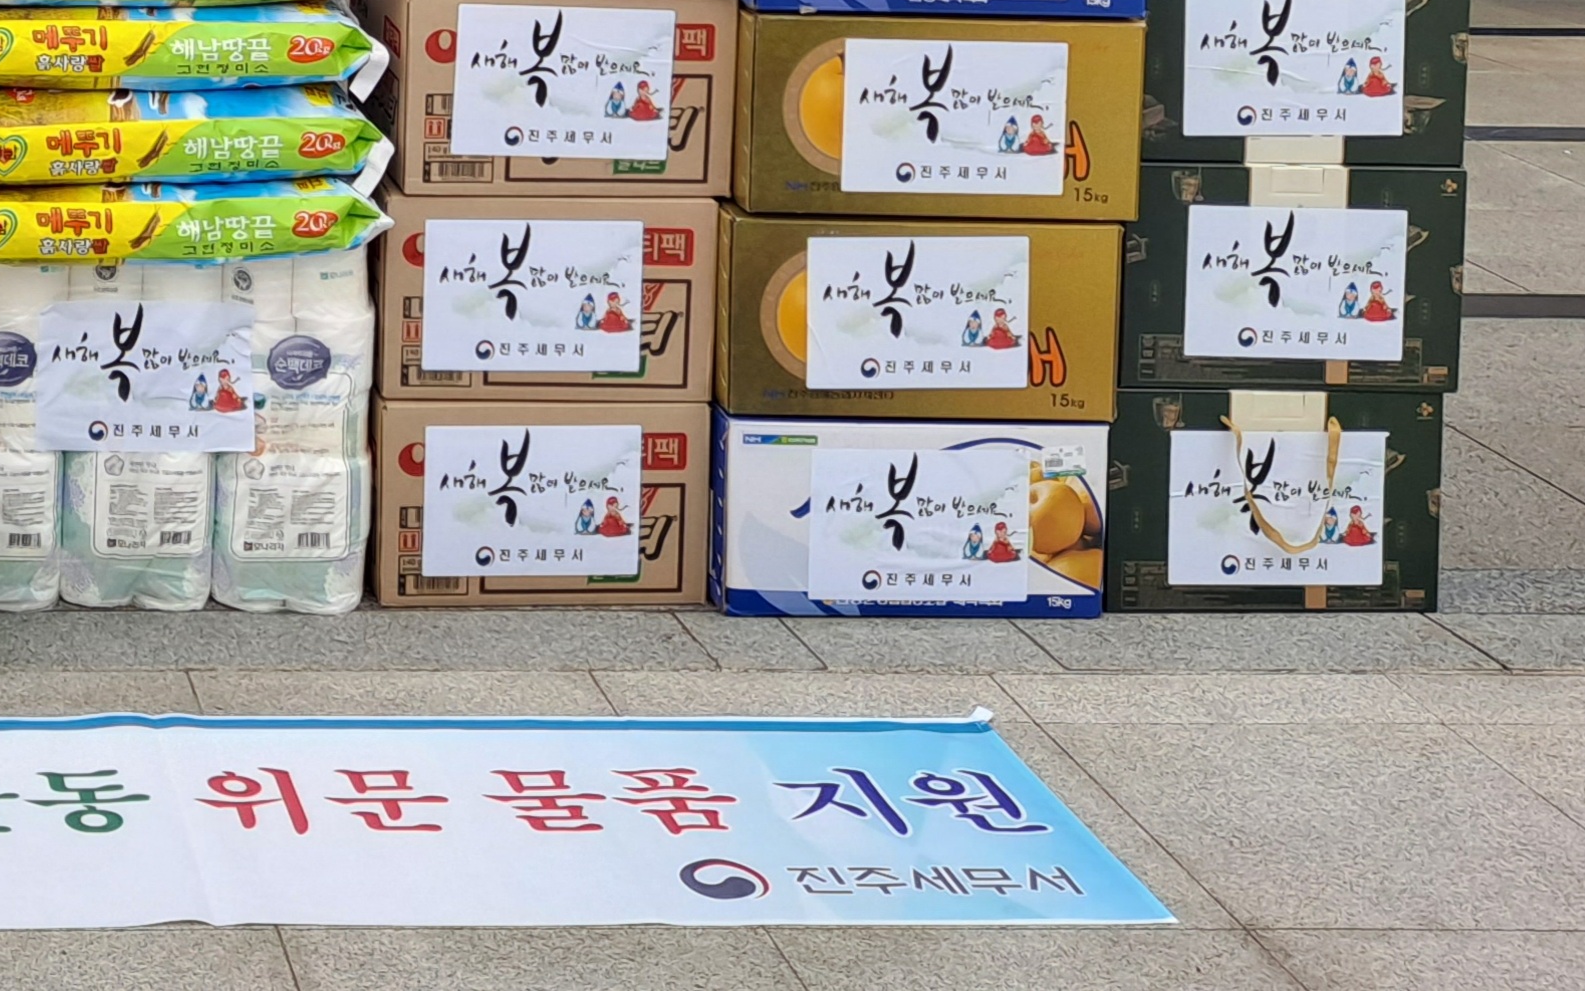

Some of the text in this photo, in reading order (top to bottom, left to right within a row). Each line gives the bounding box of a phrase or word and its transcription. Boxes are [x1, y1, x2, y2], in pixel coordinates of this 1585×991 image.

[31, 25, 109, 52] 메뚜기
[1199, 20, 1247, 49] 새해
[168, 37, 272, 63] 해남땅끝
[1261, 107, 1346, 121] 진주세무서
[46, 128, 123, 159] 메뚜기
[181, 133, 284, 164] 해남땅끝
[1073, 187, 1109, 204] 15kg
[51, 332, 98, 361] 새해
[100, 303, 143, 401] 복
[1049, 392, 1085, 409] 15kg
[113, 423, 198, 440] 진주세무서
[439, 460, 486, 490] 새해
[487, 429, 530, 526] 복
[1184, 468, 1231, 497] 새해
[1232, 437, 1274, 535] 복
[825, 483, 873, 512] 새해
[874, 452, 918, 550] 복
[499, 547, 583, 562] 진주세무서
[1244, 556, 1328, 571] 진주세무서
[886, 572, 971, 587] 진주세무서
[197, 767, 446, 836] 위문
[482, 767, 740, 836] 물품
[772, 766, 1054, 836] 지원
[784, 863, 1085, 898] 진주세무서
